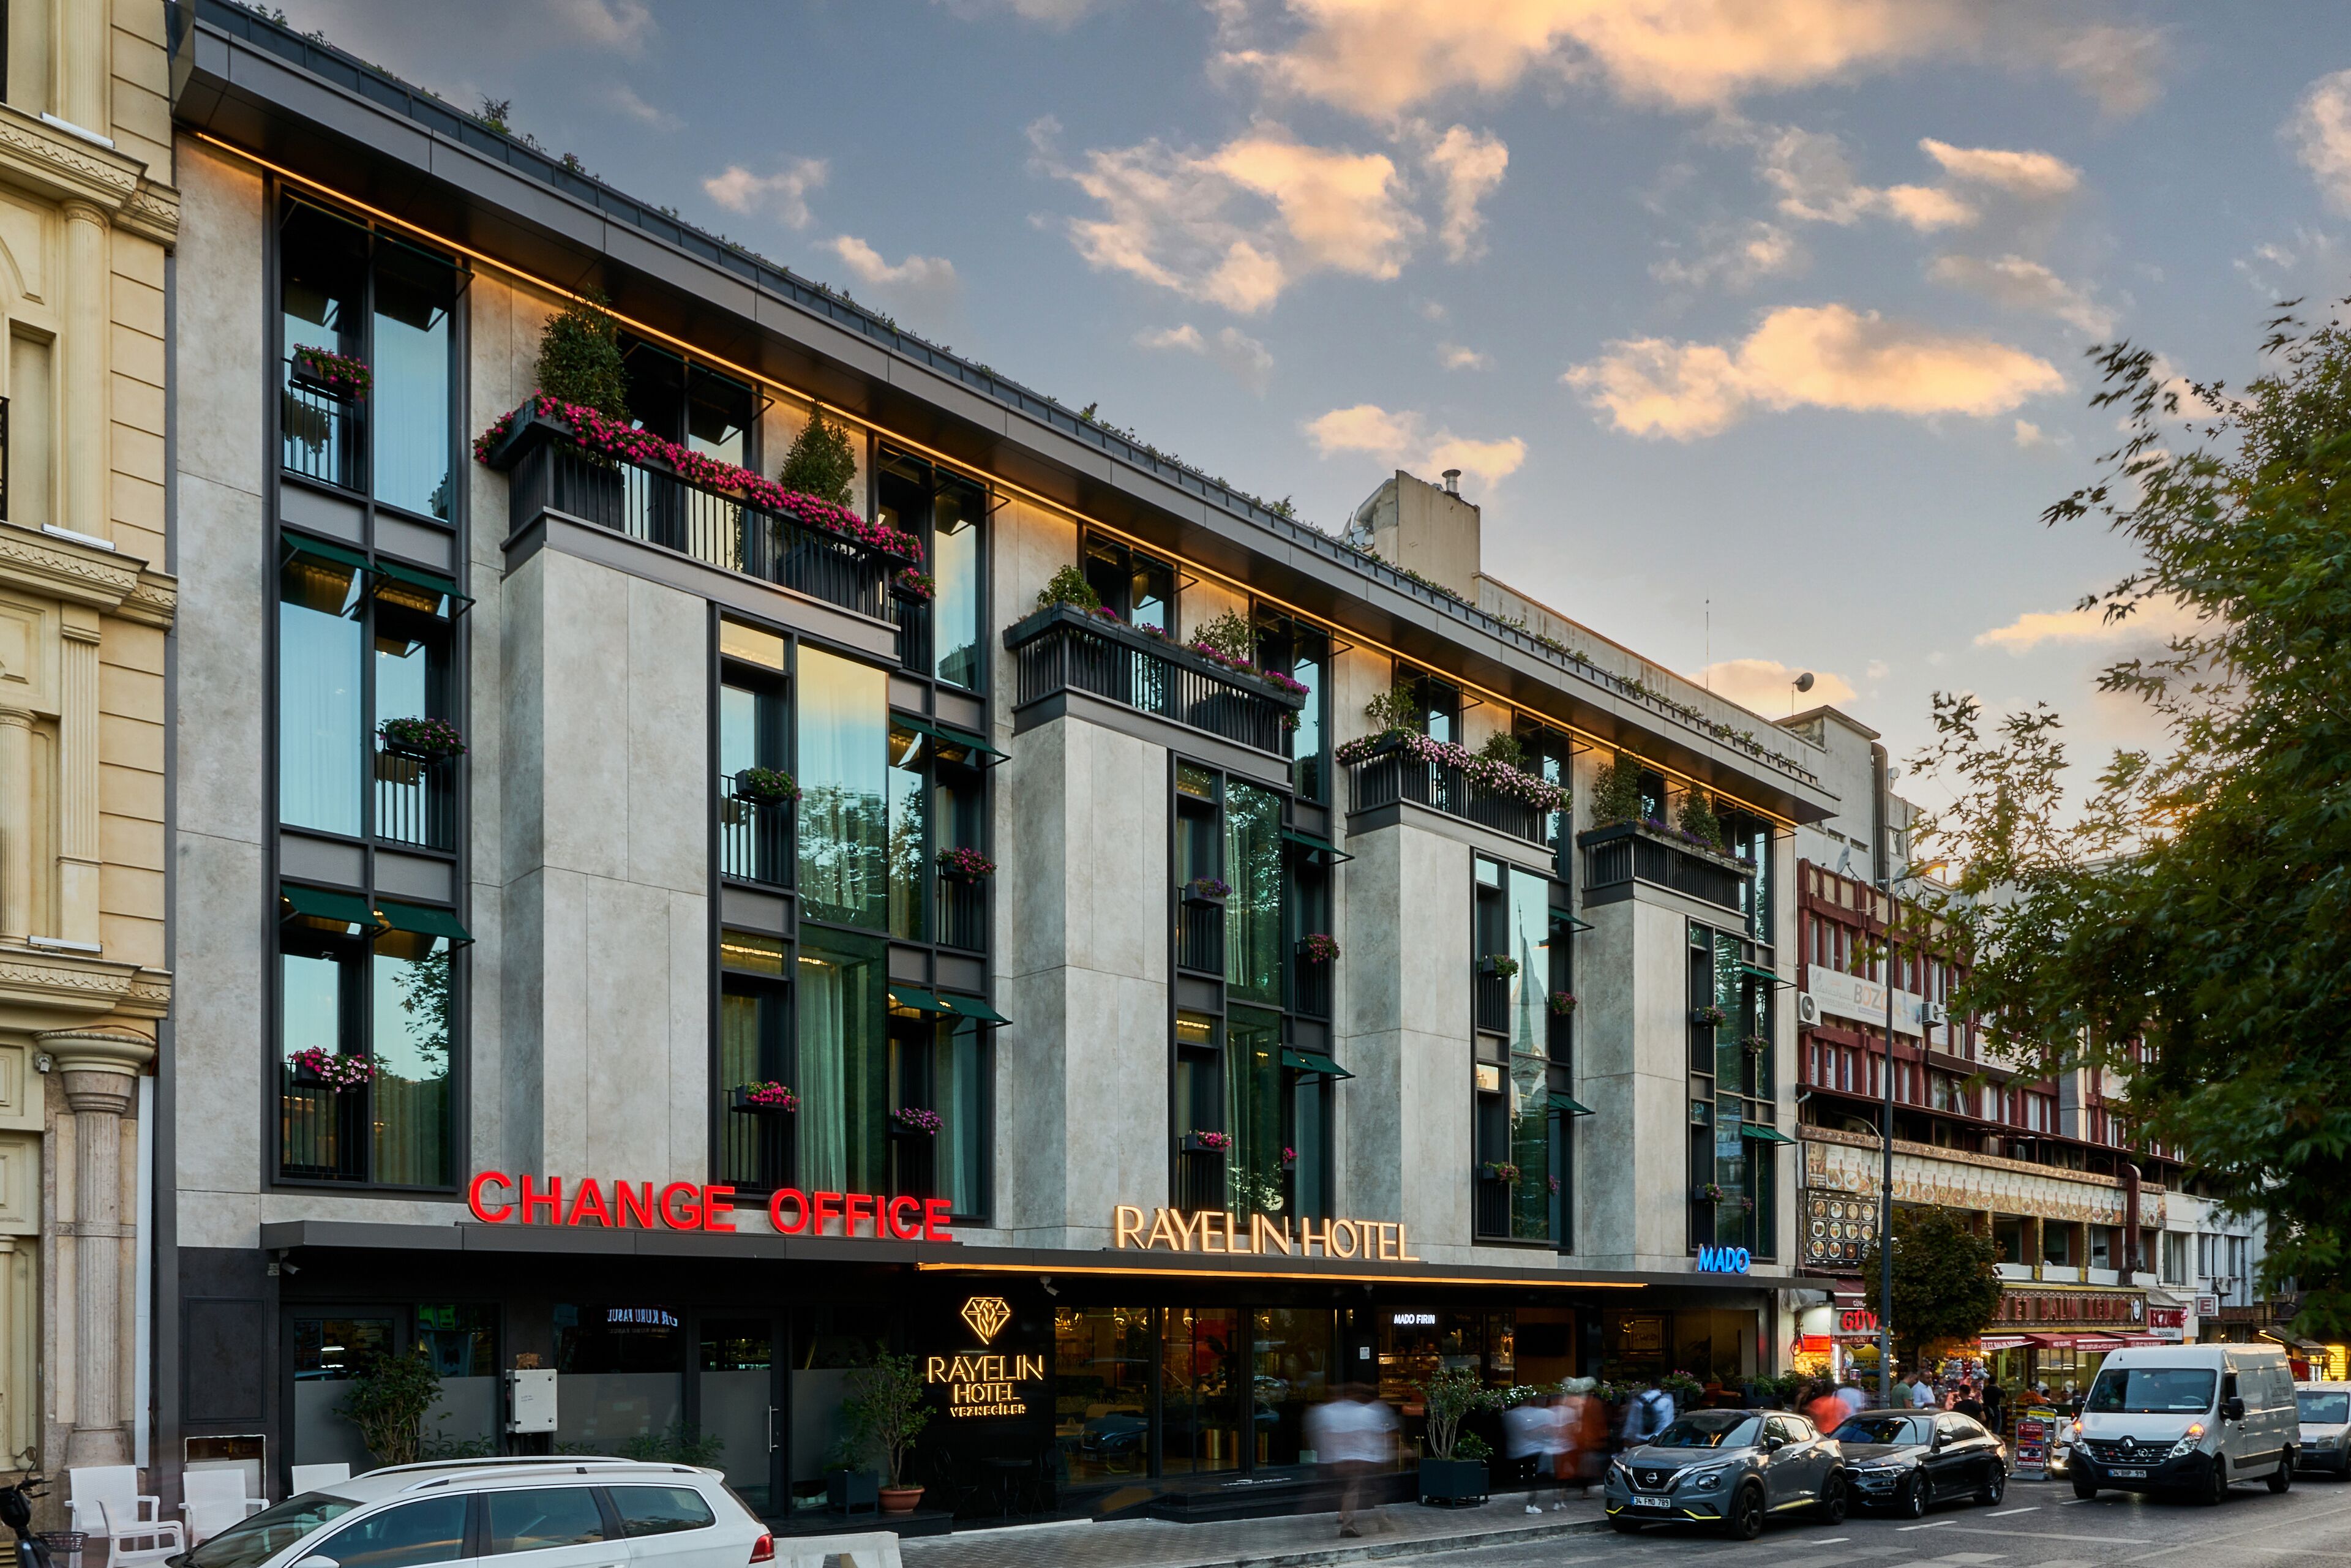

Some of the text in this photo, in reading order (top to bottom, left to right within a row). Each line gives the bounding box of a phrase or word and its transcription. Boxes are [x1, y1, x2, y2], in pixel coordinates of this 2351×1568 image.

[467, 1170, 954, 1242] CHANGE OFFICE
[1115, 1205, 1420, 1261] RAYELIN HOTEL
[1697, 1245, 1750, 1274] MADO
[1393, 1313, 1436, 1324] MADO FIRIN
[2200, 1300, 2211, 1312] E
[927, 1354, 1044, 1383] RAYELIN
[953, 1382, 1023, 1404] HOTEL
